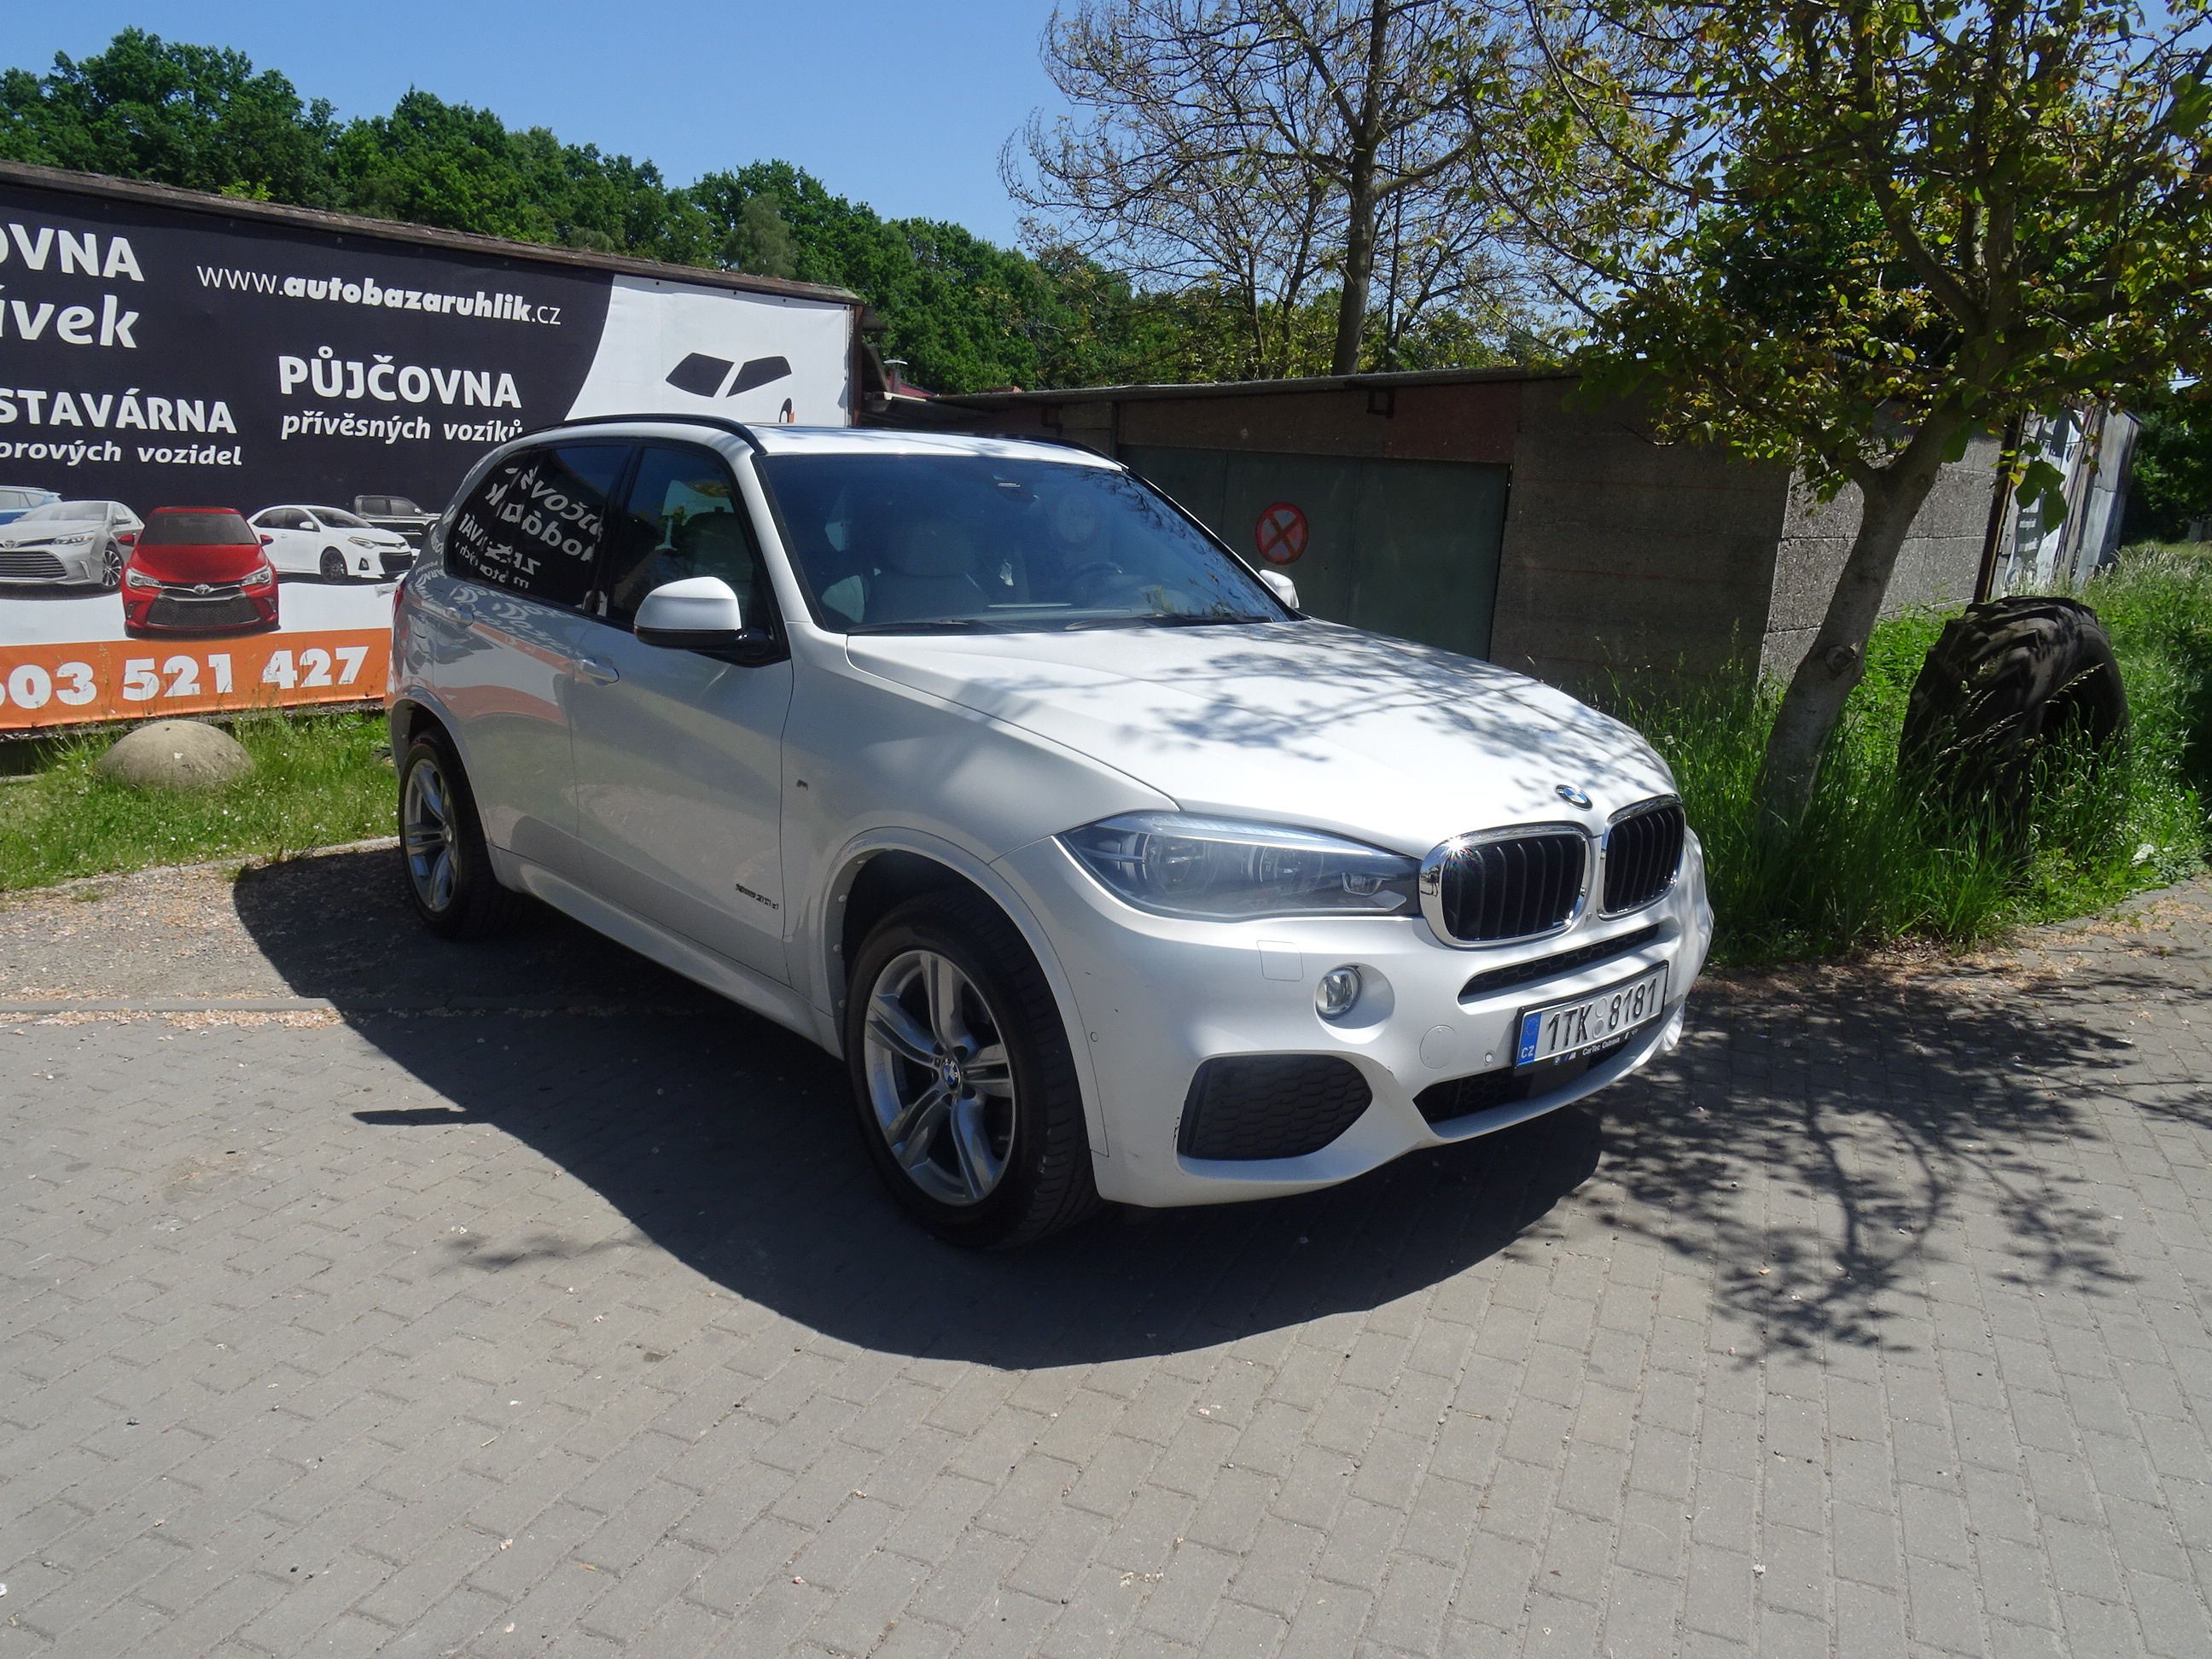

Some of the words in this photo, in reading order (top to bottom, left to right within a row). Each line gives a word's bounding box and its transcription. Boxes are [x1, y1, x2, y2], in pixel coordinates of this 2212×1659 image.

[0, 224, 144, 282] VNA
[0, 285, 139, 348] vek
[197, 266, 561, 324] www.autobazaruhlik.cz
[279, 346, 521, 408] PŮJČOVNA
[0, 388, 236, 434] STAVÁRNA
[282, 410, 430, 444] přívěsných
[137, 445, 242, 465] vozidel
[0, 661, 96, 709] 03
[123, 654, 233, 701] 521
[262, 646, 369, 689] 427
[1546, 1002, 1593, 1051] 1TK
[1609, 977, 1657, 1029] 8181
[1521, 1045, 1535, 1059] CZ
